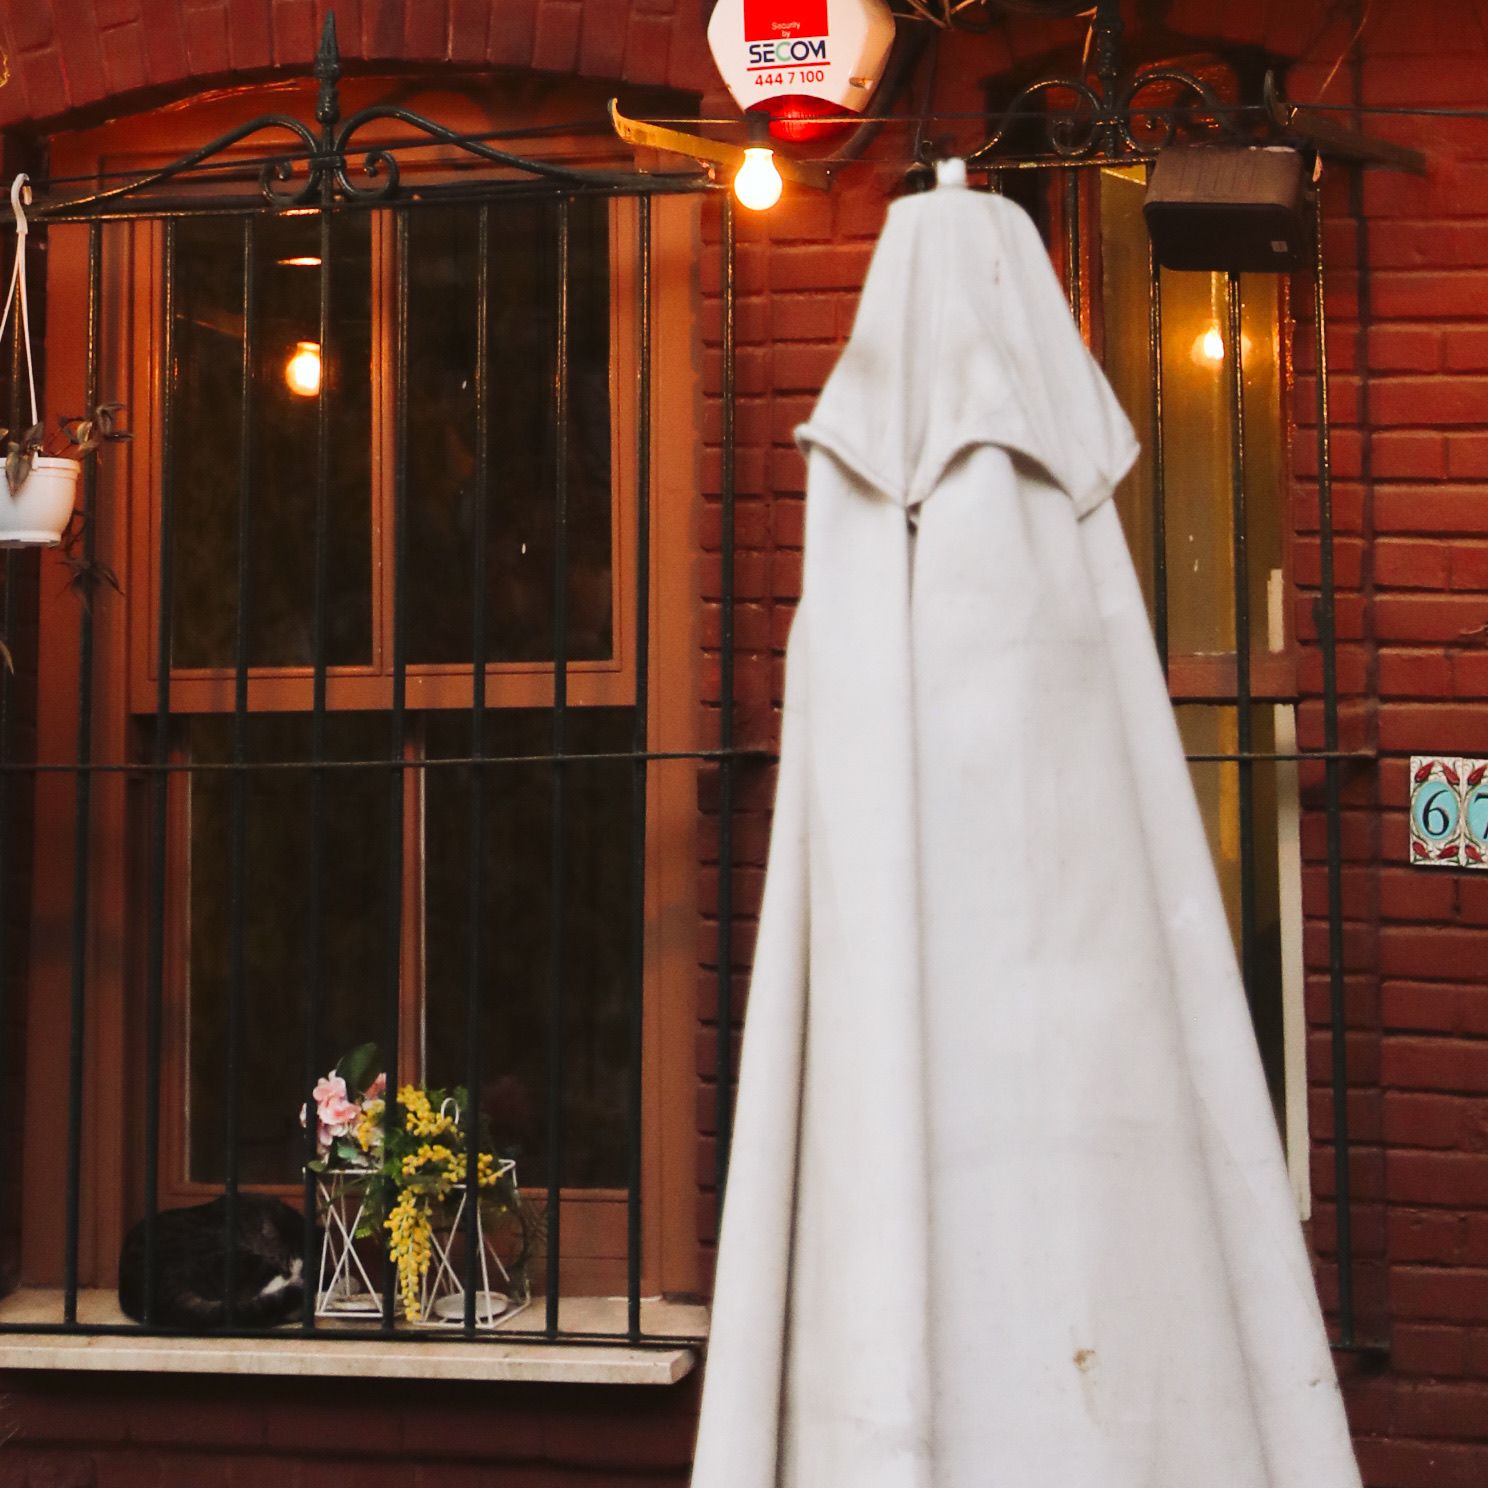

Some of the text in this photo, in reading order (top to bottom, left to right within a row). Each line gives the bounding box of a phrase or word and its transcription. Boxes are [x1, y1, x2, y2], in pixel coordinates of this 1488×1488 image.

[771, 21, 800, 30] Security
[781, 30, 791, 38] by
[749, 40, 826, 64] SECOM
[755, 70, 824, 86] 444 7 100
